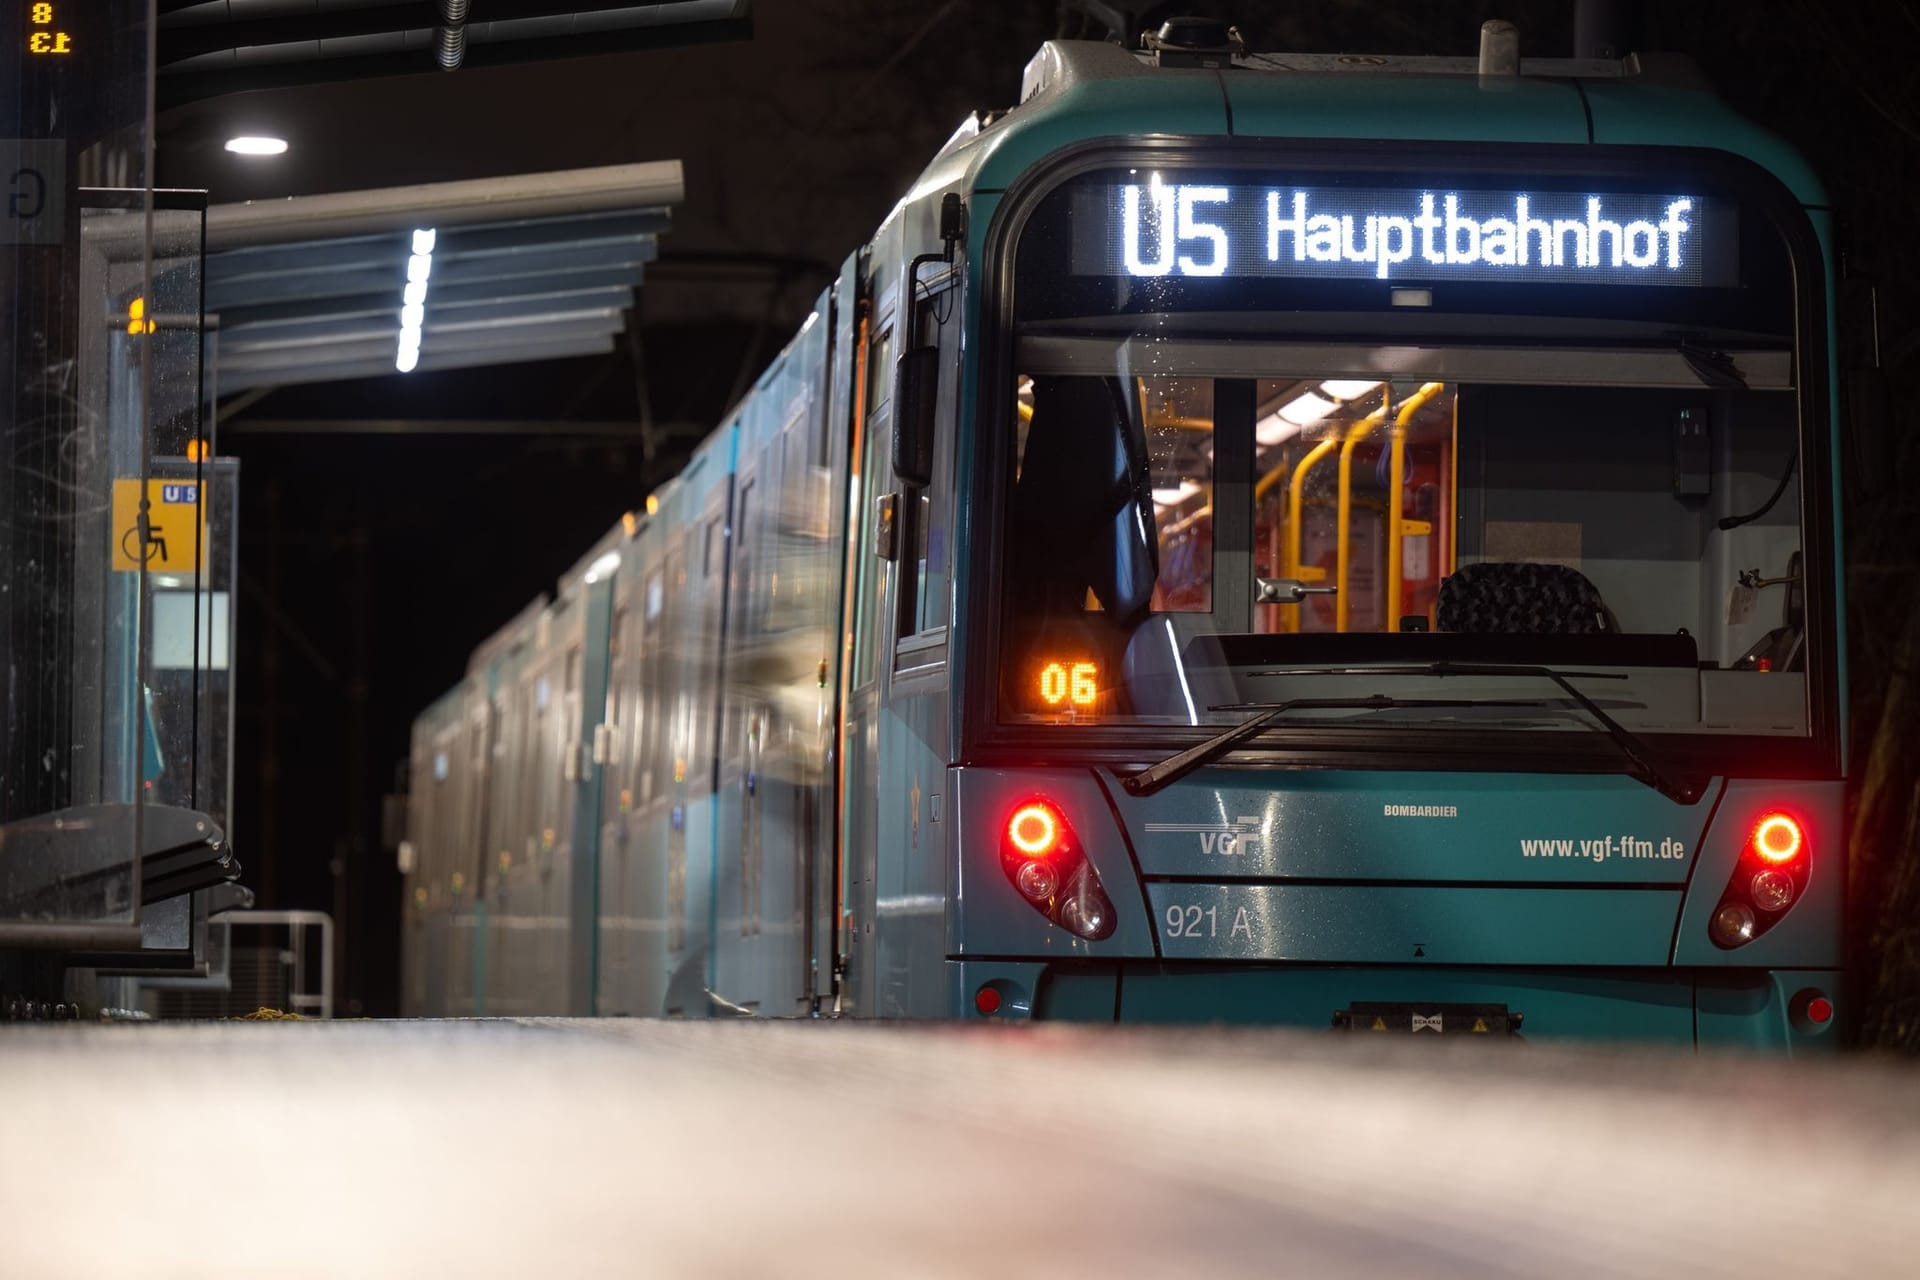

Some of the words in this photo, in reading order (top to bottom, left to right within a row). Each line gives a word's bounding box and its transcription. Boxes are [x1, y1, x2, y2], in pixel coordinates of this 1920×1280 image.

[1123, 185, 1229, 277] U5
[1267, 191, 1692, 279] Hauptbahnhof
[1041, 663, 1097, 704] 06
[1384, 804, 1458, 818] BOMBARDIER
[1200, 816, 1259, 856] VGF
[1520, 835, 1685, 863] www.vgf-ffm.de
[1166, 904, 1218, 938] 921
[1230, 905, 1252, 939] A
